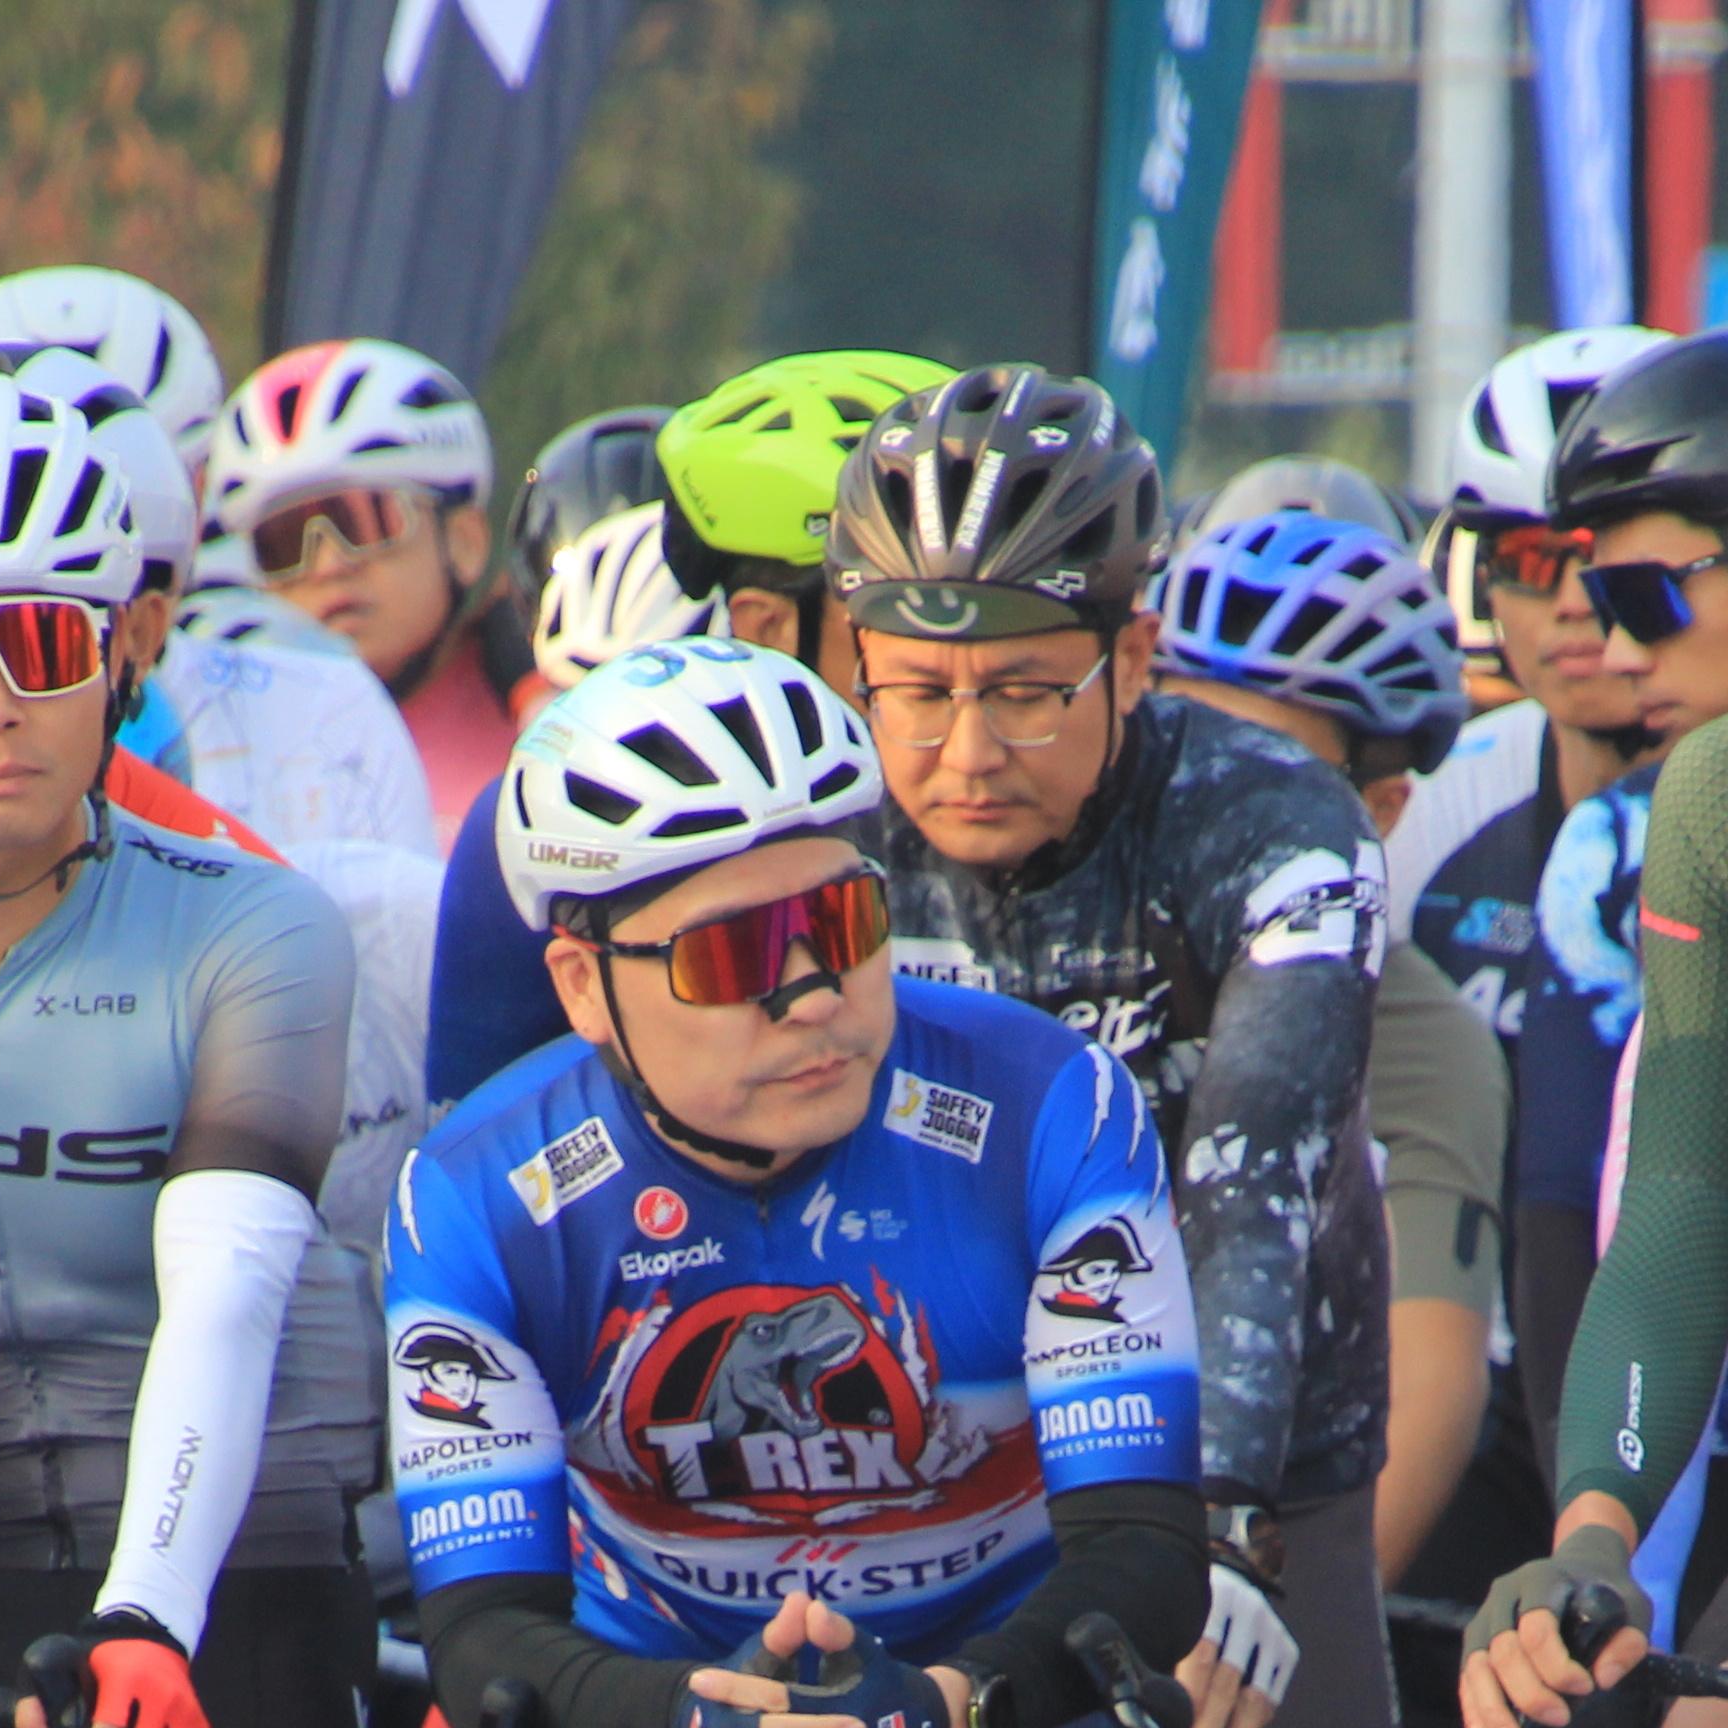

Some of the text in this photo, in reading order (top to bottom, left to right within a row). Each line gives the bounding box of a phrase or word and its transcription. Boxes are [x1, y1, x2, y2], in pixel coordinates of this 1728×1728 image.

[33, 995, 137, 1017] X-LAB
[620, 1237, 725, 1282] Ekopak
[1025, 1331, 1163, 1365] NAPOLEON
[1056, 1359, 1122, 1378] SPORTS
[399, 1431, 533, 1471] NAPOLEON
[426, 1458, 493, 1481] SPORTS
[644, 1422, 915, 1498] T REX
[149, 1425, 202, 1559] MONTON
